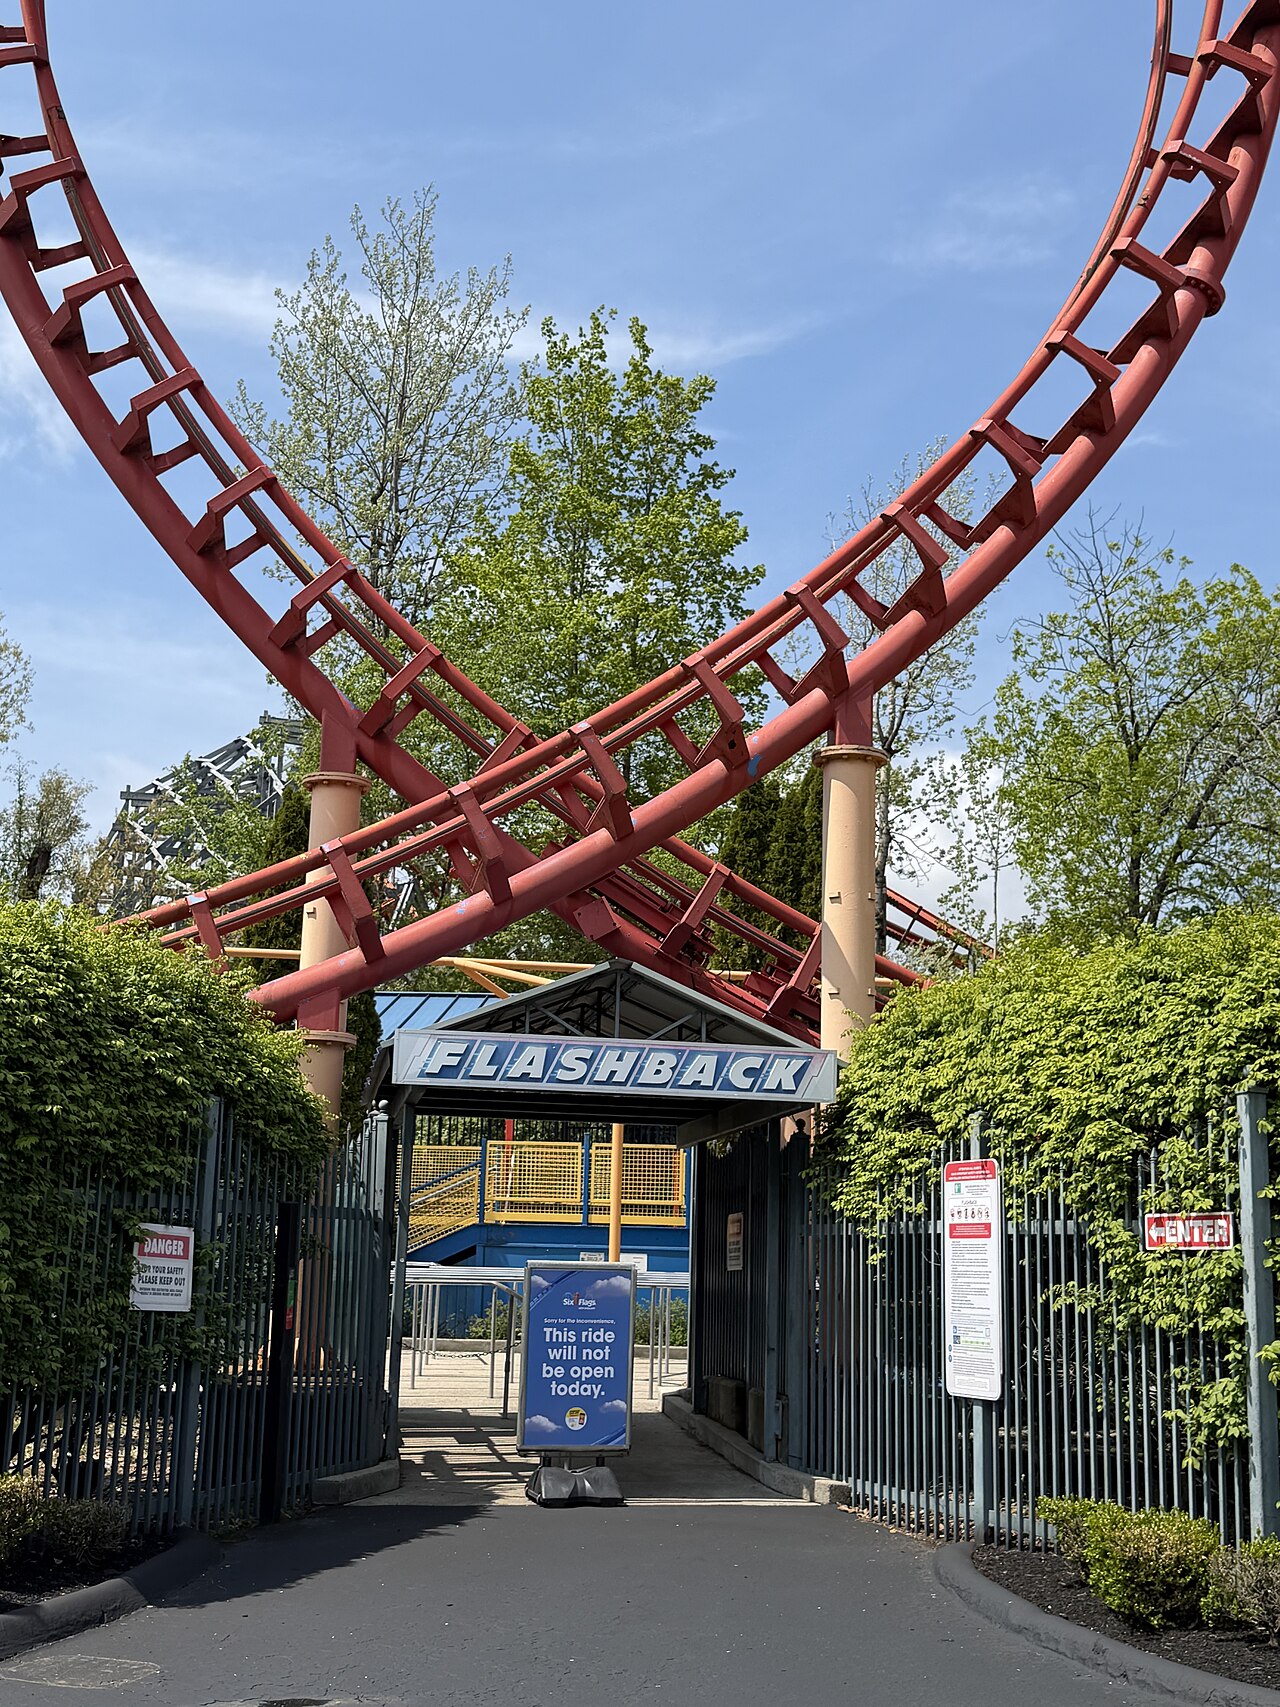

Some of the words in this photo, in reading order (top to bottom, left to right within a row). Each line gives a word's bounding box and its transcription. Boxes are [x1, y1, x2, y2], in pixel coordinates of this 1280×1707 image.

[425, 1040, 811, 1091] FLASHBACK
[1165, 1219, 1228, 1242] ENTER
[143, 1237, 184, 1256] DANGER
[152, 1265, 166, 1274] YOUR
[167, 1266, 184, 1275] SAFETY
[138, 1274, 158, 1285] PLEASE
[159, 1276, 173, 1285] KEEP
[174, 1277, 186, 1286] OUT
[562, 1298, 575, 1306] Six
[578, 1298, 597, 1307] Flags
[543, 1327, 577, 1343] This
[581, 1327, 616, 1343] ride
[547, 1345, 577, 1360] will
[582, 1345, 611, 1361] not
[542, 1363, 565, 1378] be
[570, 1365, 615, 1381] open
[550, 1380, 606, 1399] today.
